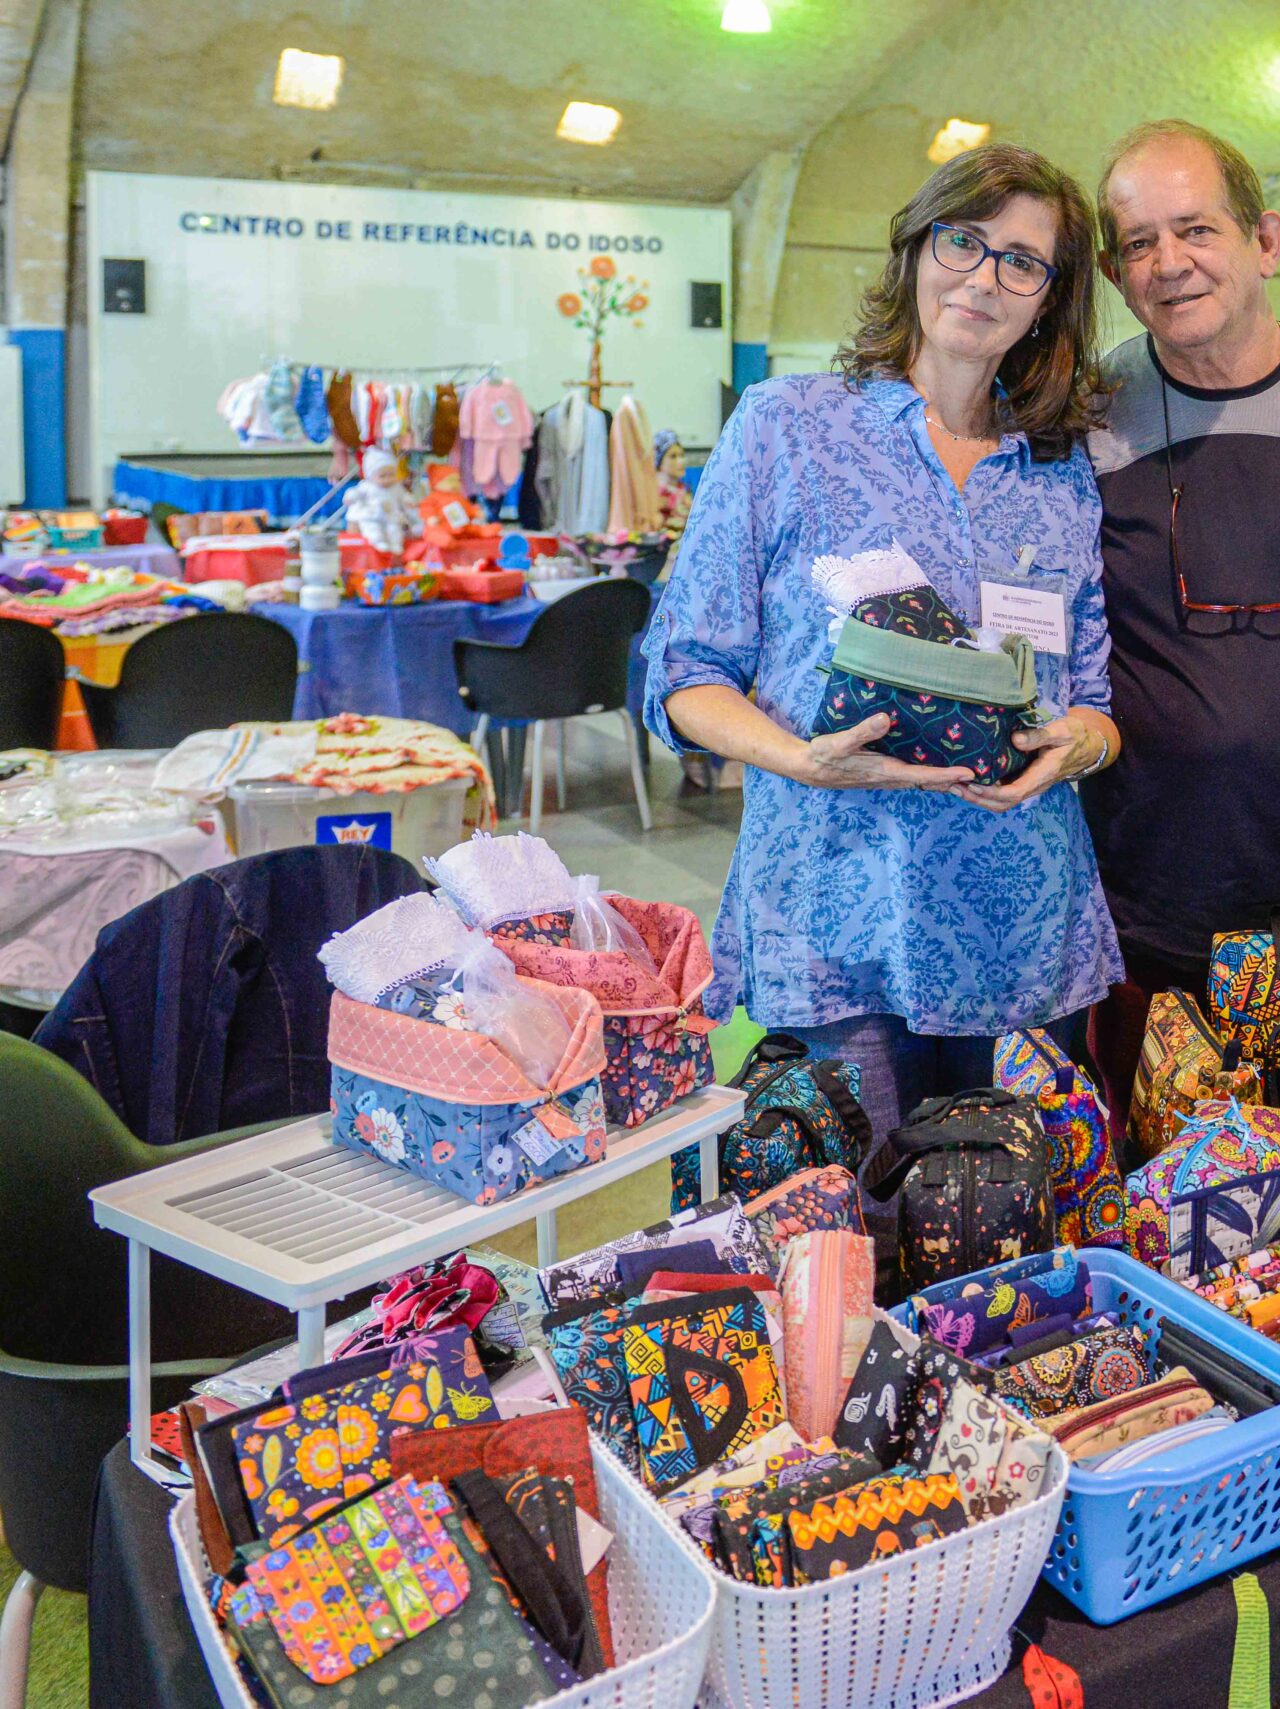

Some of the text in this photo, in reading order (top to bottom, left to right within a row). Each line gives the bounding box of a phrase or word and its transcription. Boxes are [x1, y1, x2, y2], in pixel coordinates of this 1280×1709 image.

[180, 212, 664, 254] CENTRO DE REFERÊNCIA DO IDOSO
[989, 620, 1005, 629] FEIRA
[1014, 624, 1048, 636] ARTESANATO
